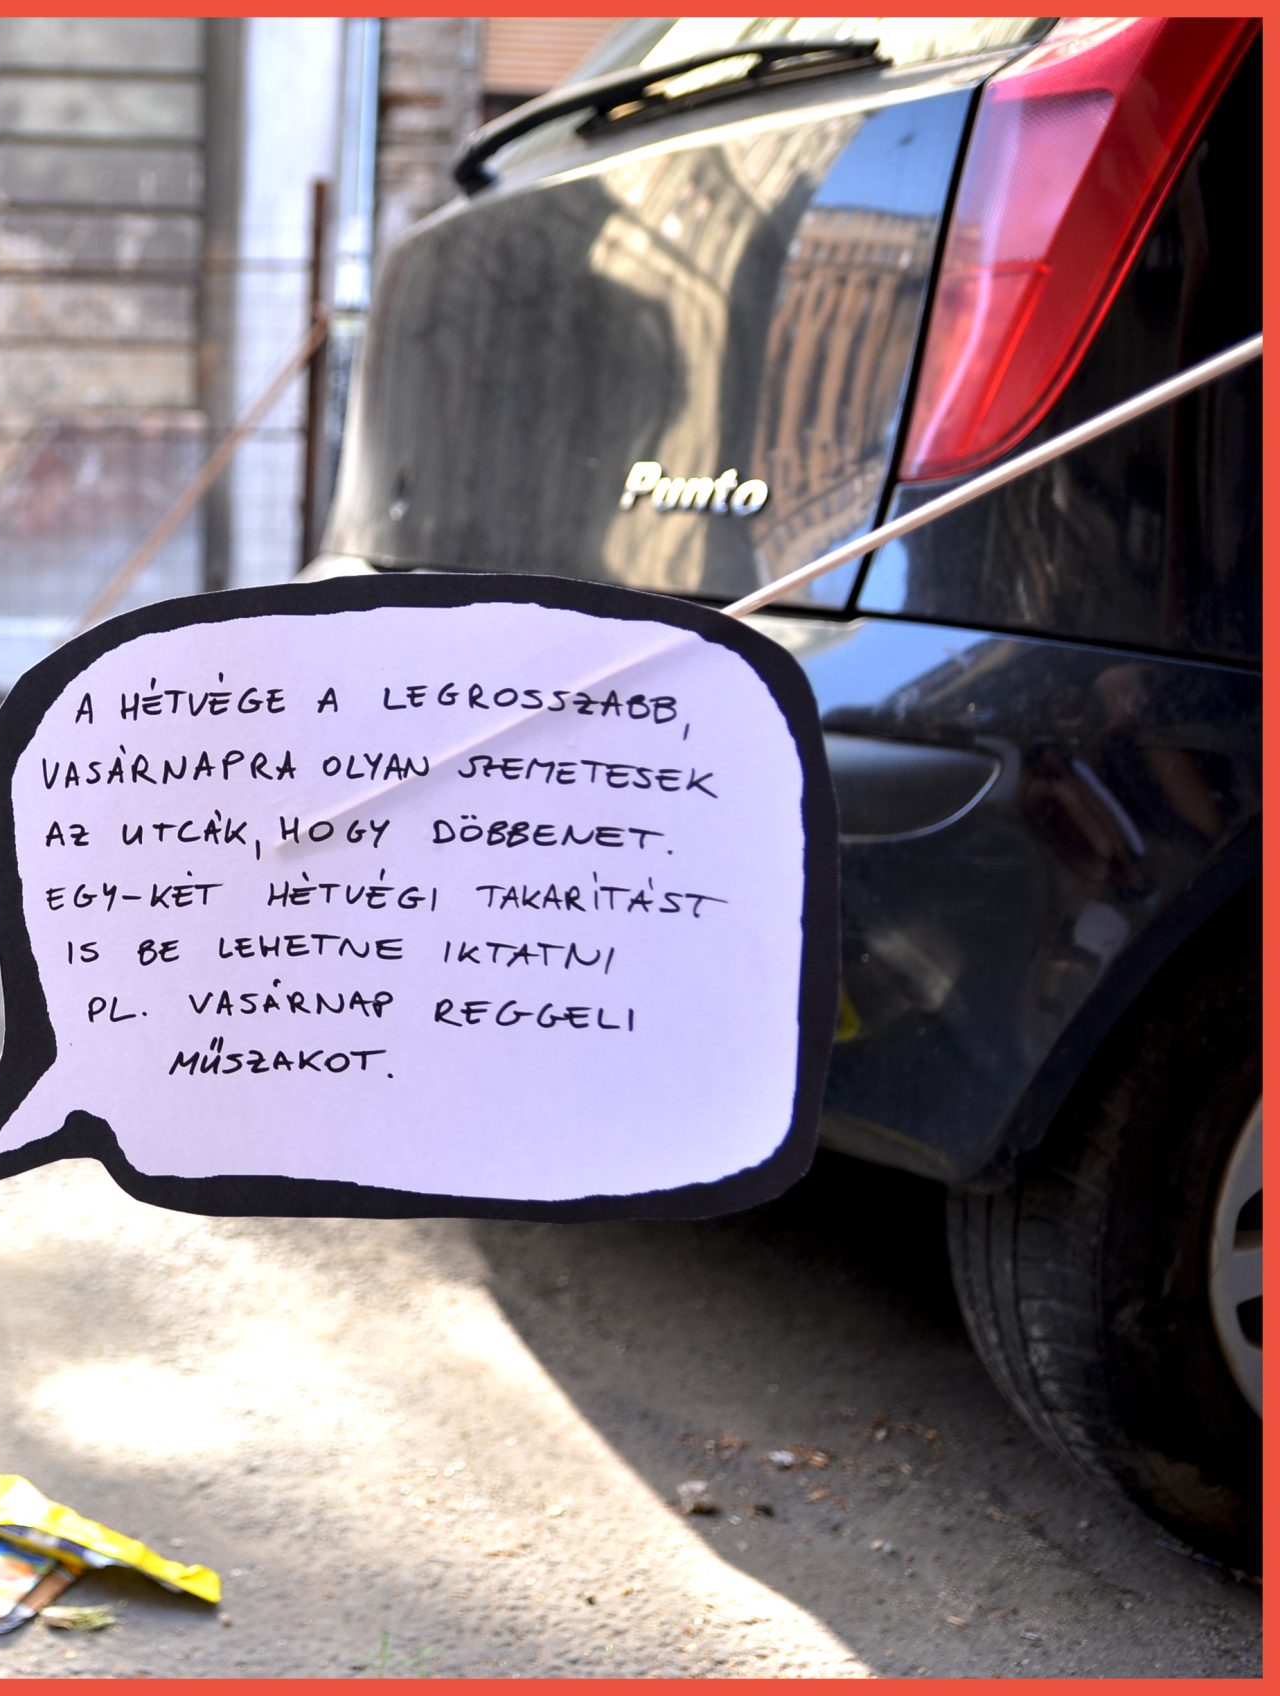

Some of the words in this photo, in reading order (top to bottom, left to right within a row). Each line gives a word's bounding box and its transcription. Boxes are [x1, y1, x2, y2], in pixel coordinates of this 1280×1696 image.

[619, 460, 769, 518] Punto
[75, 692, 93, 724] A
[120, 671, 285, 721] HÉTVÉGE
[317, 687, 338, 714] A
[383, 682, 688, 737] LEGROSSZABB,
[42, 744, 297, 790] VASÁRNAPRA
[322, 752, 430, 781] OLYAN
[457, 755, 717, 798] SZEMETESEK
[45, 821, 89, 847] AZ
[122, 809, 261, 861] UTCÁK,
[279, 816, 390, 849] HOGY
[432, 814, 672, 854] DÖBBENET.
[267, 868, 437, 912] HÉTVÉGI
[67, 941, 100, 965] IS
[137, 939, 180, 966] BE
[218, 933, 403, 960] LEHETNE
[444, 941, 614, 972] IKTATNI
[87, 996, 148, 1023] PL.
[188, 978, 394, 1018] VASÁRNAP
[434, 998, 634, 1031] REGGELI
[168, 1036, 394, 1079] MŰSZAKOT.
